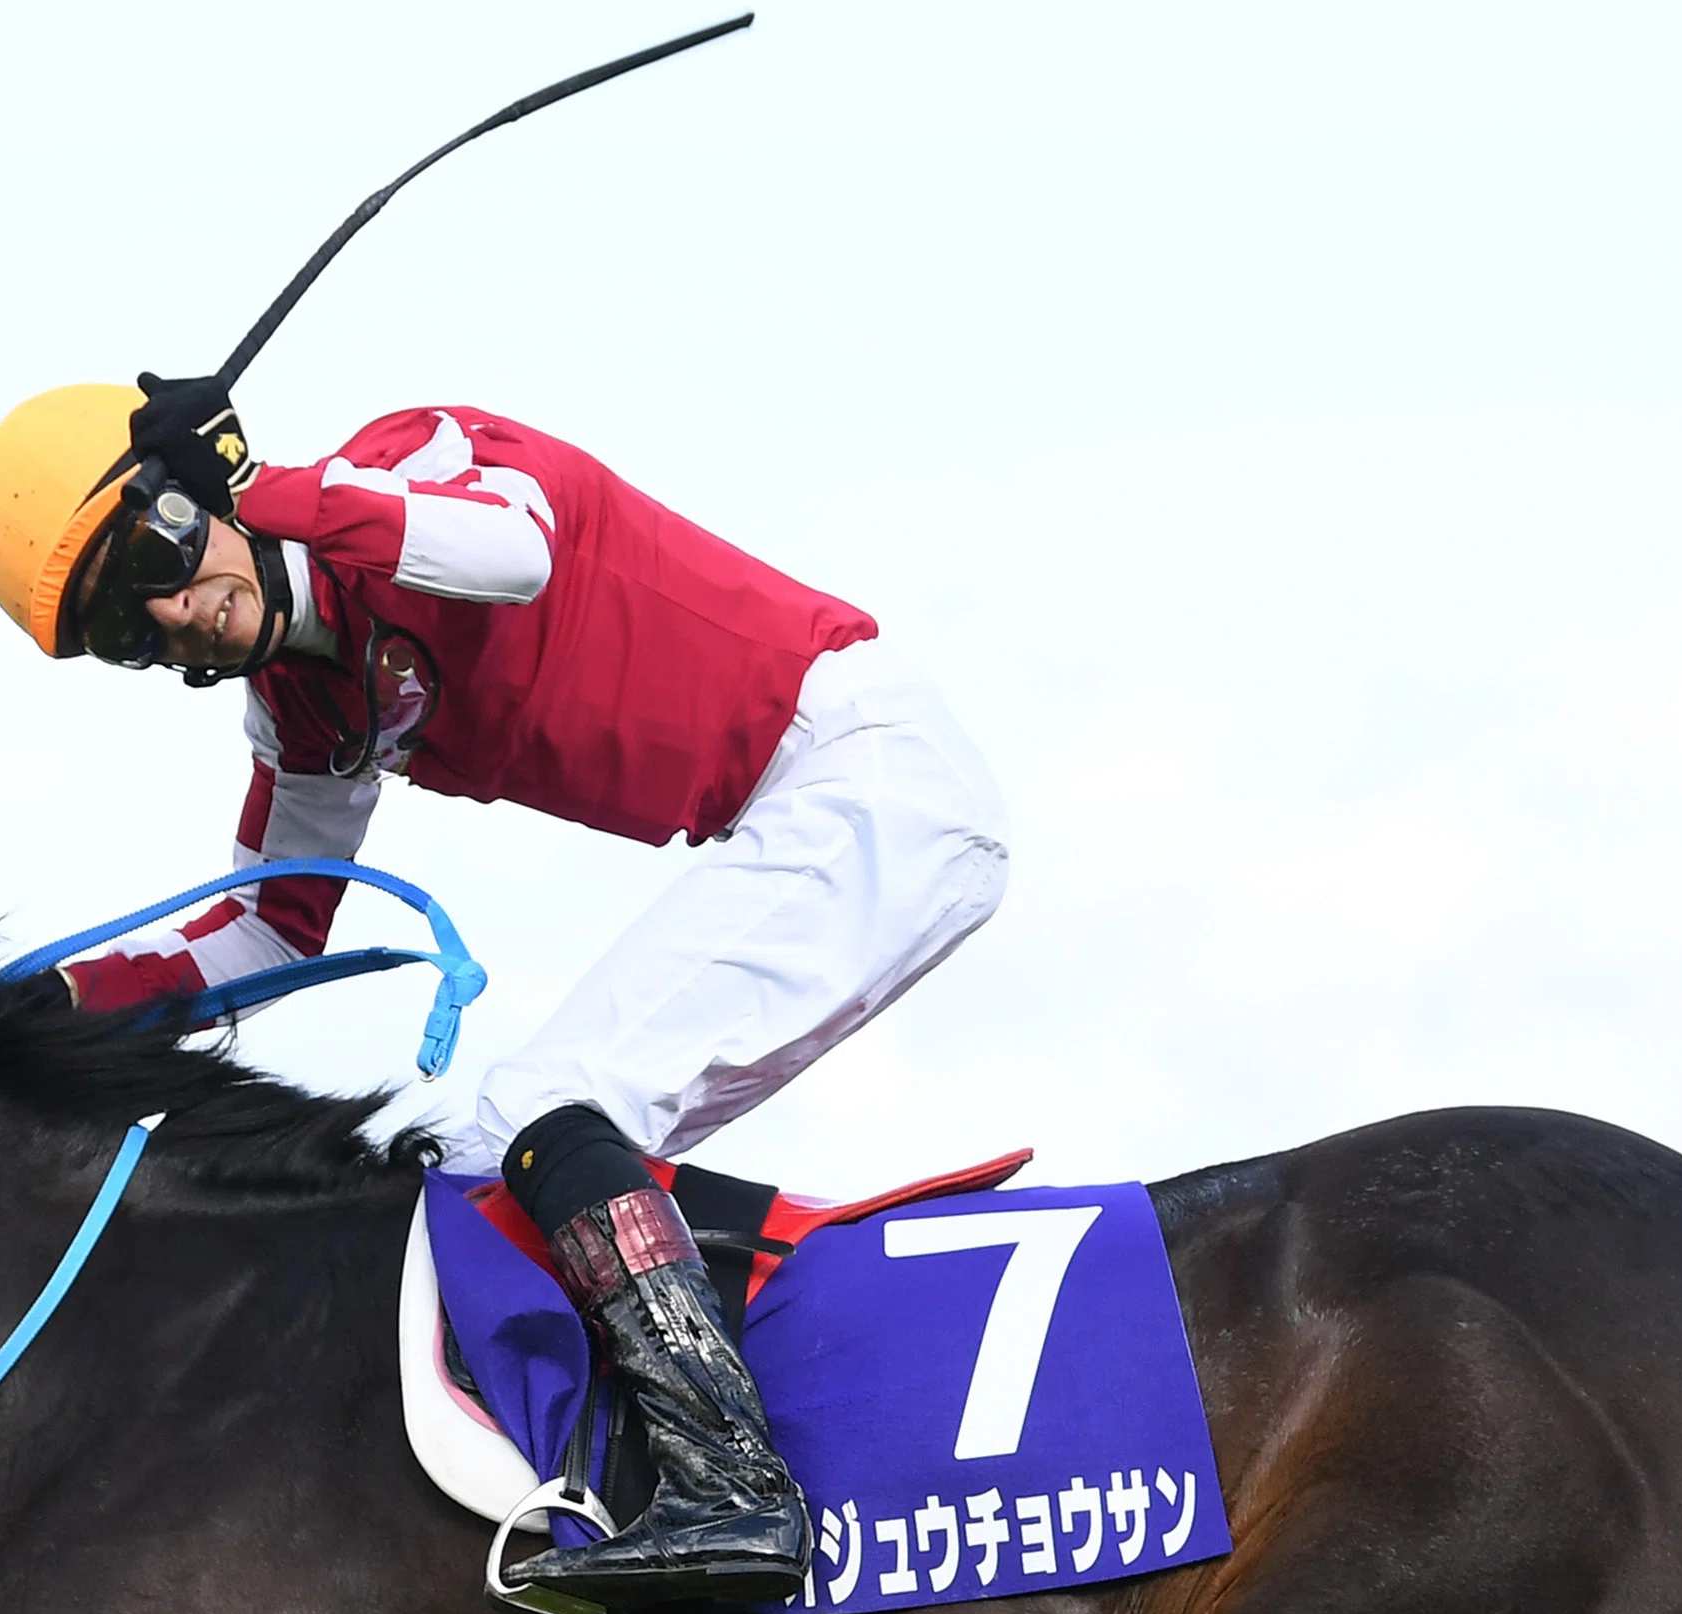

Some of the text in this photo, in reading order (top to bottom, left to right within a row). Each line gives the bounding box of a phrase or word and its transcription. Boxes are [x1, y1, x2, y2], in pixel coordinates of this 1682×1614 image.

[883, 1205, 1104, 1461] 7
[784, 1466, 1197, 1608] ジュウチョウサン
